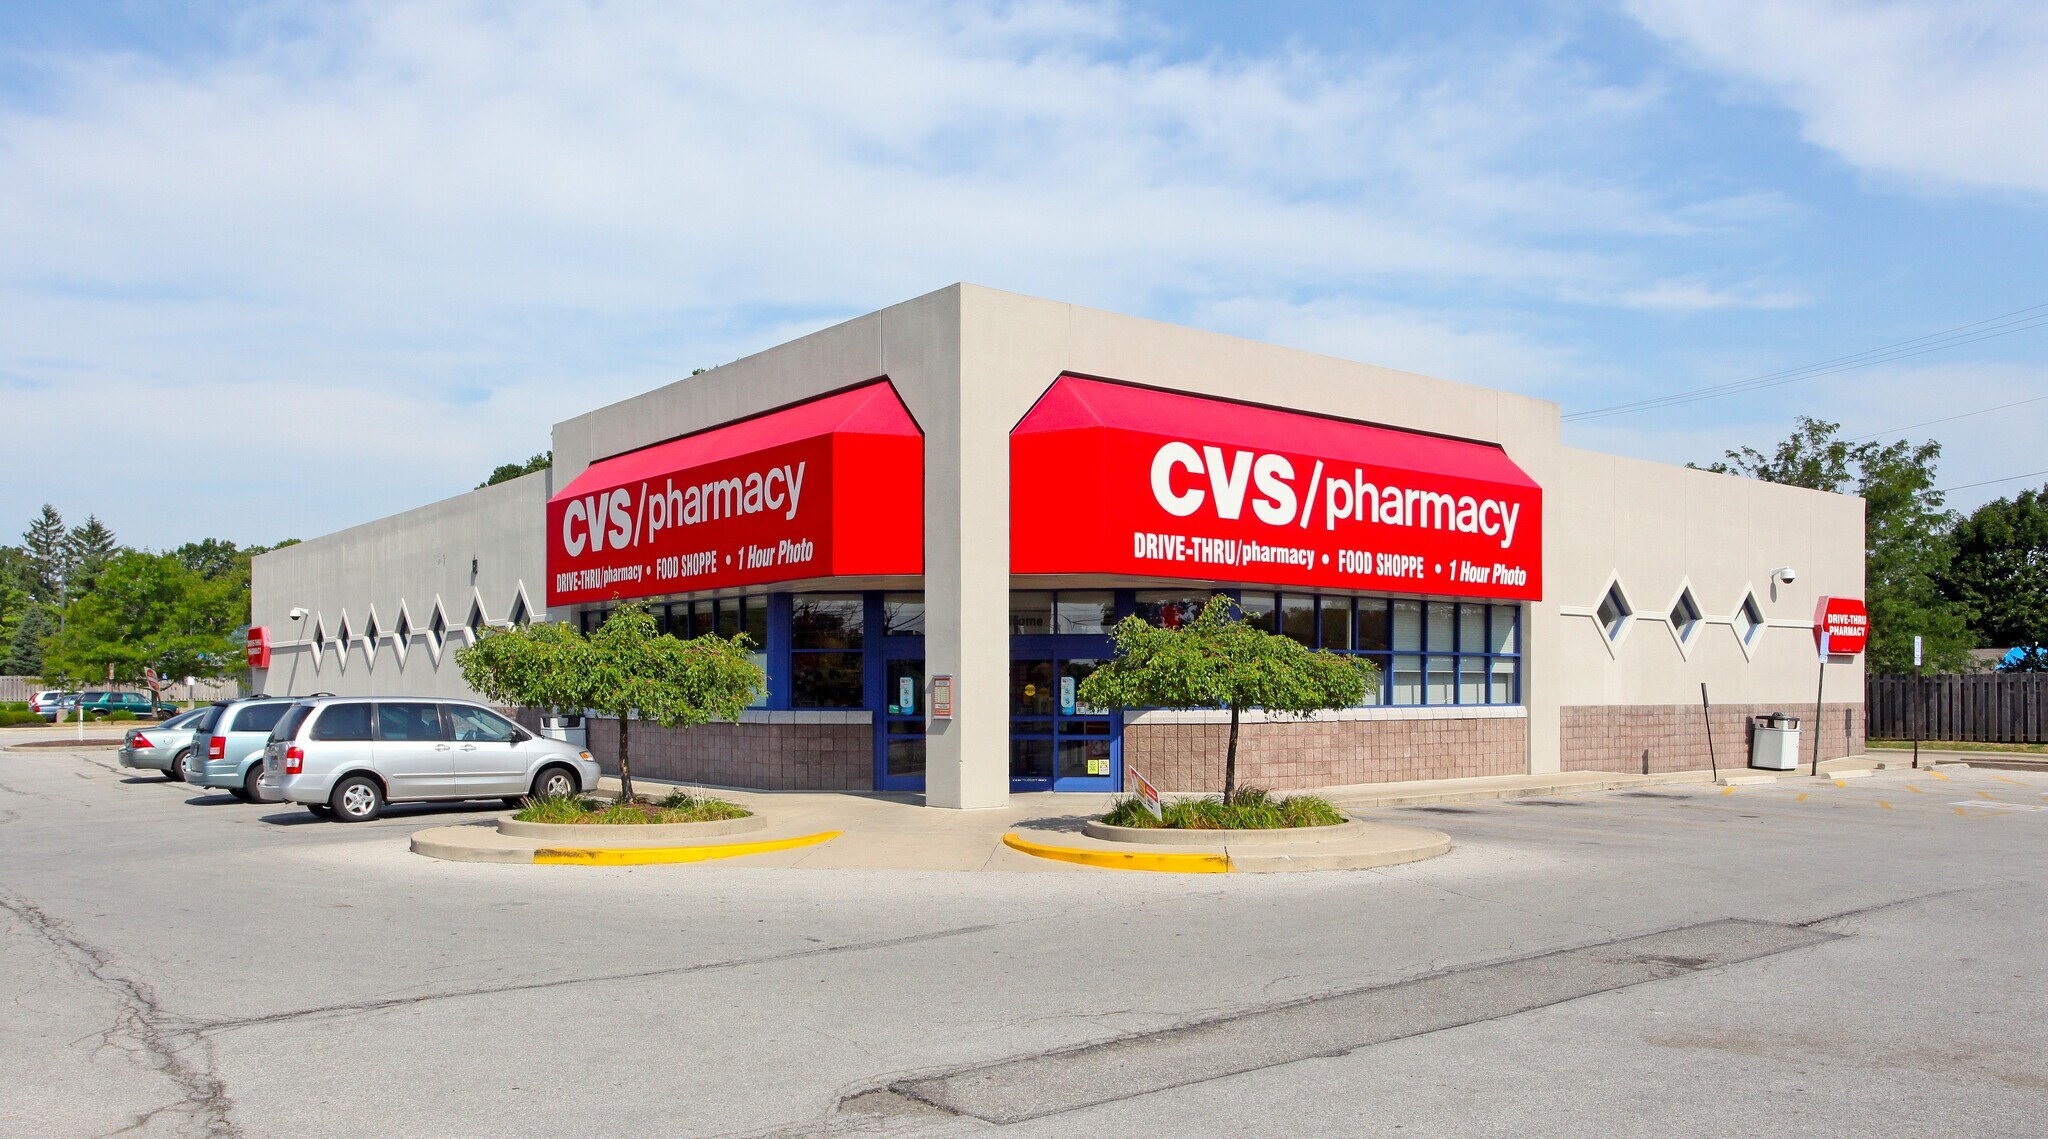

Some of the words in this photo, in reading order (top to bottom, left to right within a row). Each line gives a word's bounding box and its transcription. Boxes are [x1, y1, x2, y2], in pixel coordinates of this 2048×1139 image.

[562, 461, 806, 557] CVS/pharmacy
[1150, 441, 1520, 549] CVS/pharmacy
[556, 565, 643, 593] DRIVE-THRU/pharmacy
[656, 556, 679, 580] FOOD
[681, 550, 717, 578] SHOPPE
[738, 546, 745, 570] 1
[747, 544, 776, 570] Hour
[778, 537, 814, 565] Photo
[1134, 531, 1315, 571] DRIVE-THRU/pharmacy
[1338, 549, 1373, 575] FOOD
[1376, 552, 1424, 579] SHOPPE
[1449, 559, 1457, 581] 1
[1459, 560, 1491, 584] Hour
[1492, 563, 1527, 587] Photo
[1827, 613, 1867, 625] DRIVE-THRU
[1829, 625, 1866, 637] PHARMACY
